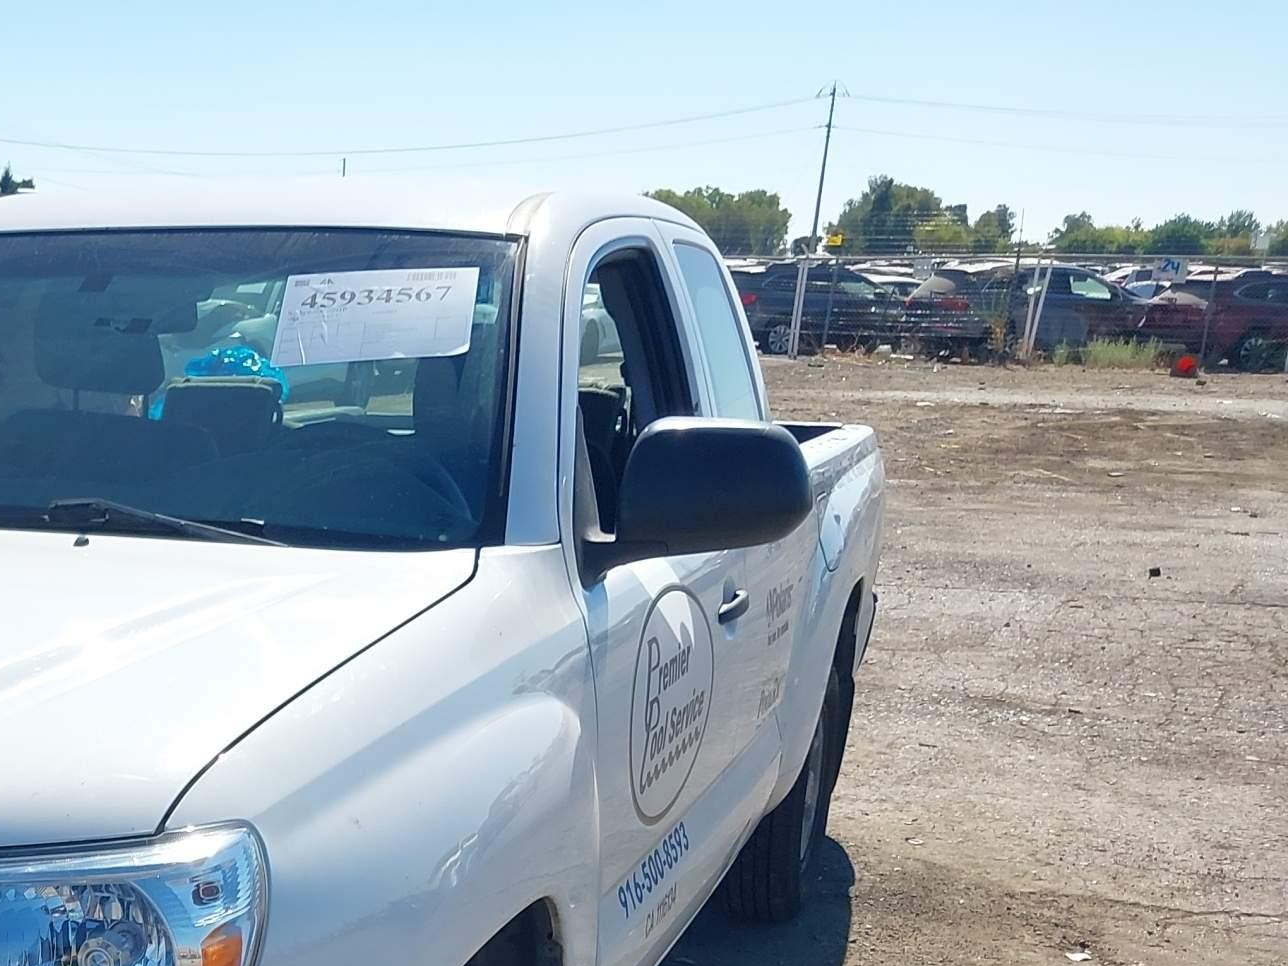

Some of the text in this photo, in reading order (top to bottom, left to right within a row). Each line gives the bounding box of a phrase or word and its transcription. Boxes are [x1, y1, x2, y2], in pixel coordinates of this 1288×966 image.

[301, 285, 453, 309] 45934567
[1162, 257, 1181, 276] 24
[646, 636, 691, 716] Premier
[643, 696, 669, 778] Pool
[668, 688, 705, 745] Service
[618, 821, 689, 920] 916-500-8593
